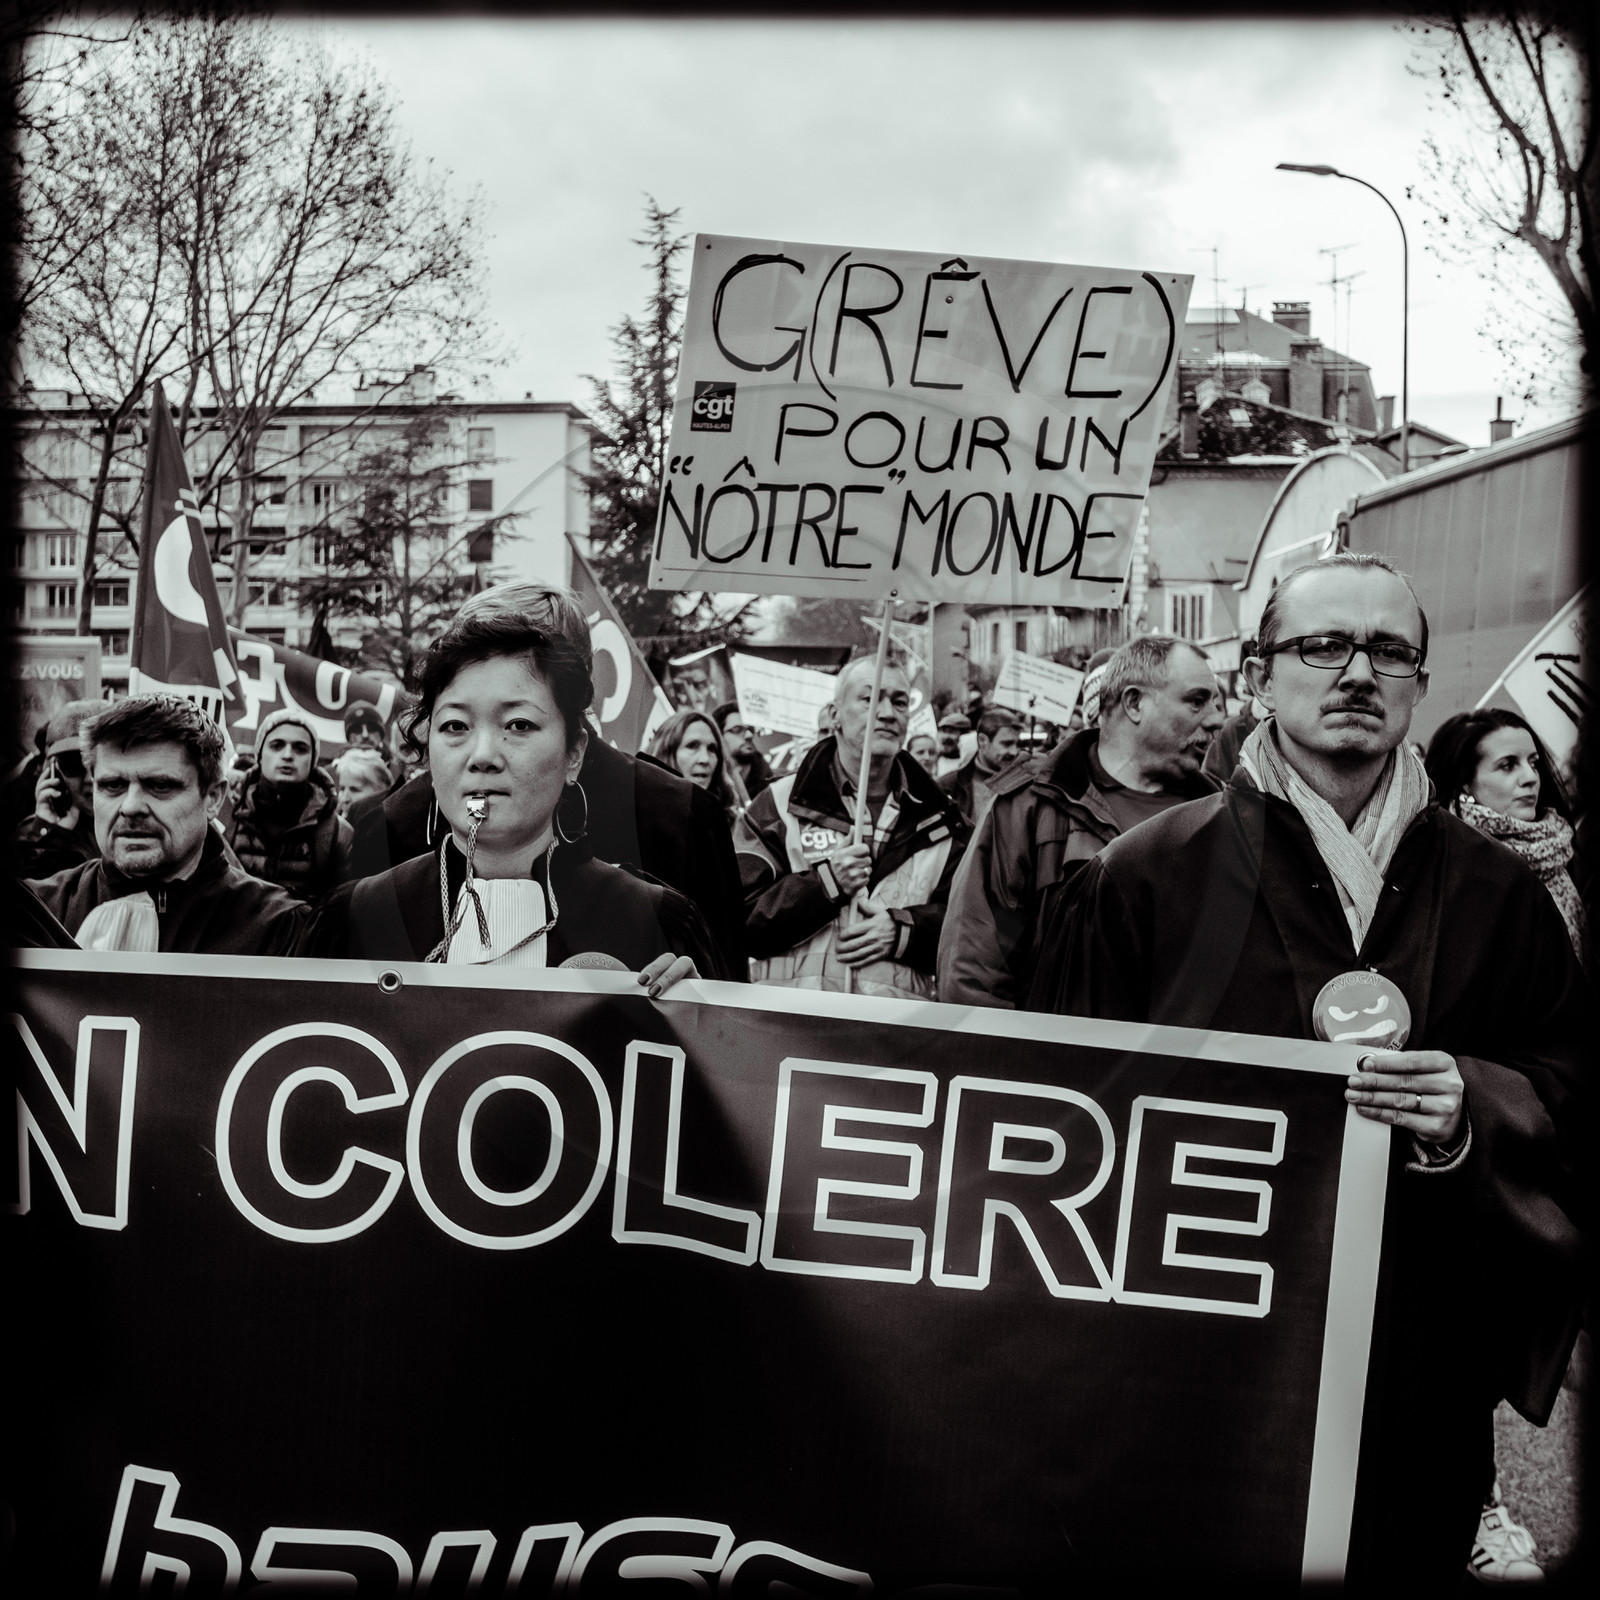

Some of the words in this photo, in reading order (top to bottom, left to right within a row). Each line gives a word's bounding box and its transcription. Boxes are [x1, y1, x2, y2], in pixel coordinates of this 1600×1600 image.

[694, 394, 734, 419] cgt
[774, 403, 1011, 475] POUR
[1036, 415, 1130, 475] UN
[893, 488, 1145, 583] MONDE
[1330, 973, 1383, 995] AVOCAT
[215, 1022, 1287, 1318] COLERE
